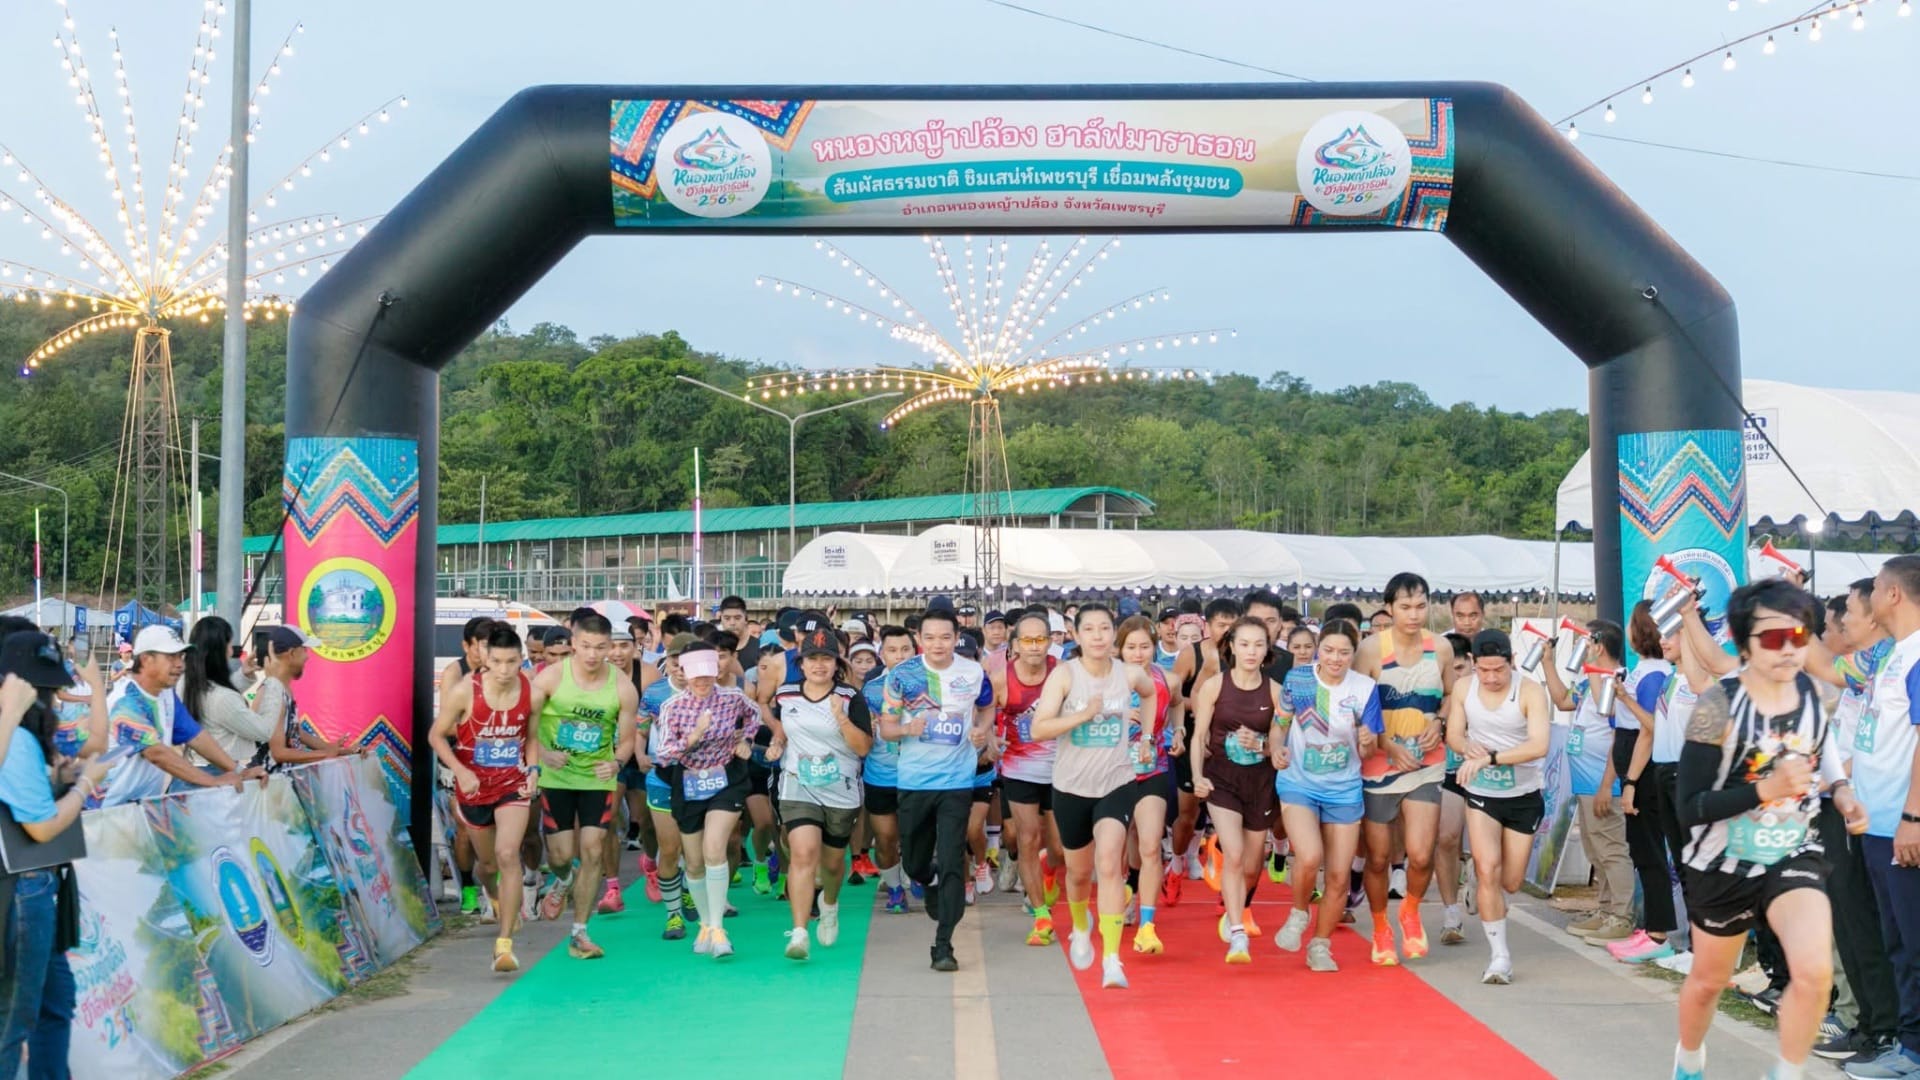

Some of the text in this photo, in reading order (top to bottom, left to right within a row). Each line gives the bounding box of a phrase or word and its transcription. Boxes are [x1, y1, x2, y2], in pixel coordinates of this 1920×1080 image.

[812, 117, 1256, 162] หนองหญ้าปล้อง ฮาล์ฟมาราธอน
[672, 165, 757, 187] หนองหญ้าปล้อง
[832, 163, 1230, 196] สัมผัสธรรมชาติ ชิมเสน่ห์เพชรบุรี เชื่อมพลังชุมชน
[1312, 163, 1396, 186] หนองหญ้าปล้อง
[698, 194, 737, 207] 2569
[1333, 192, 1374, 205] 2569
[901, 196, 1166, 217] อำเภอหนองหญ้าปล้อง จังหวัดเพชรบุรี
[573, 730, 600, 743] 607
[933, 722, 962, 736] 400
[1088, 722, 1120, 737] 503
[490, 746, 518, 760] 342
[1320, 752, 1346, 765] 732
[1484, 769, 1513, 781] 504
[696, 776, 725, 792] 355
[1753, 828, 1801, 848] 632
